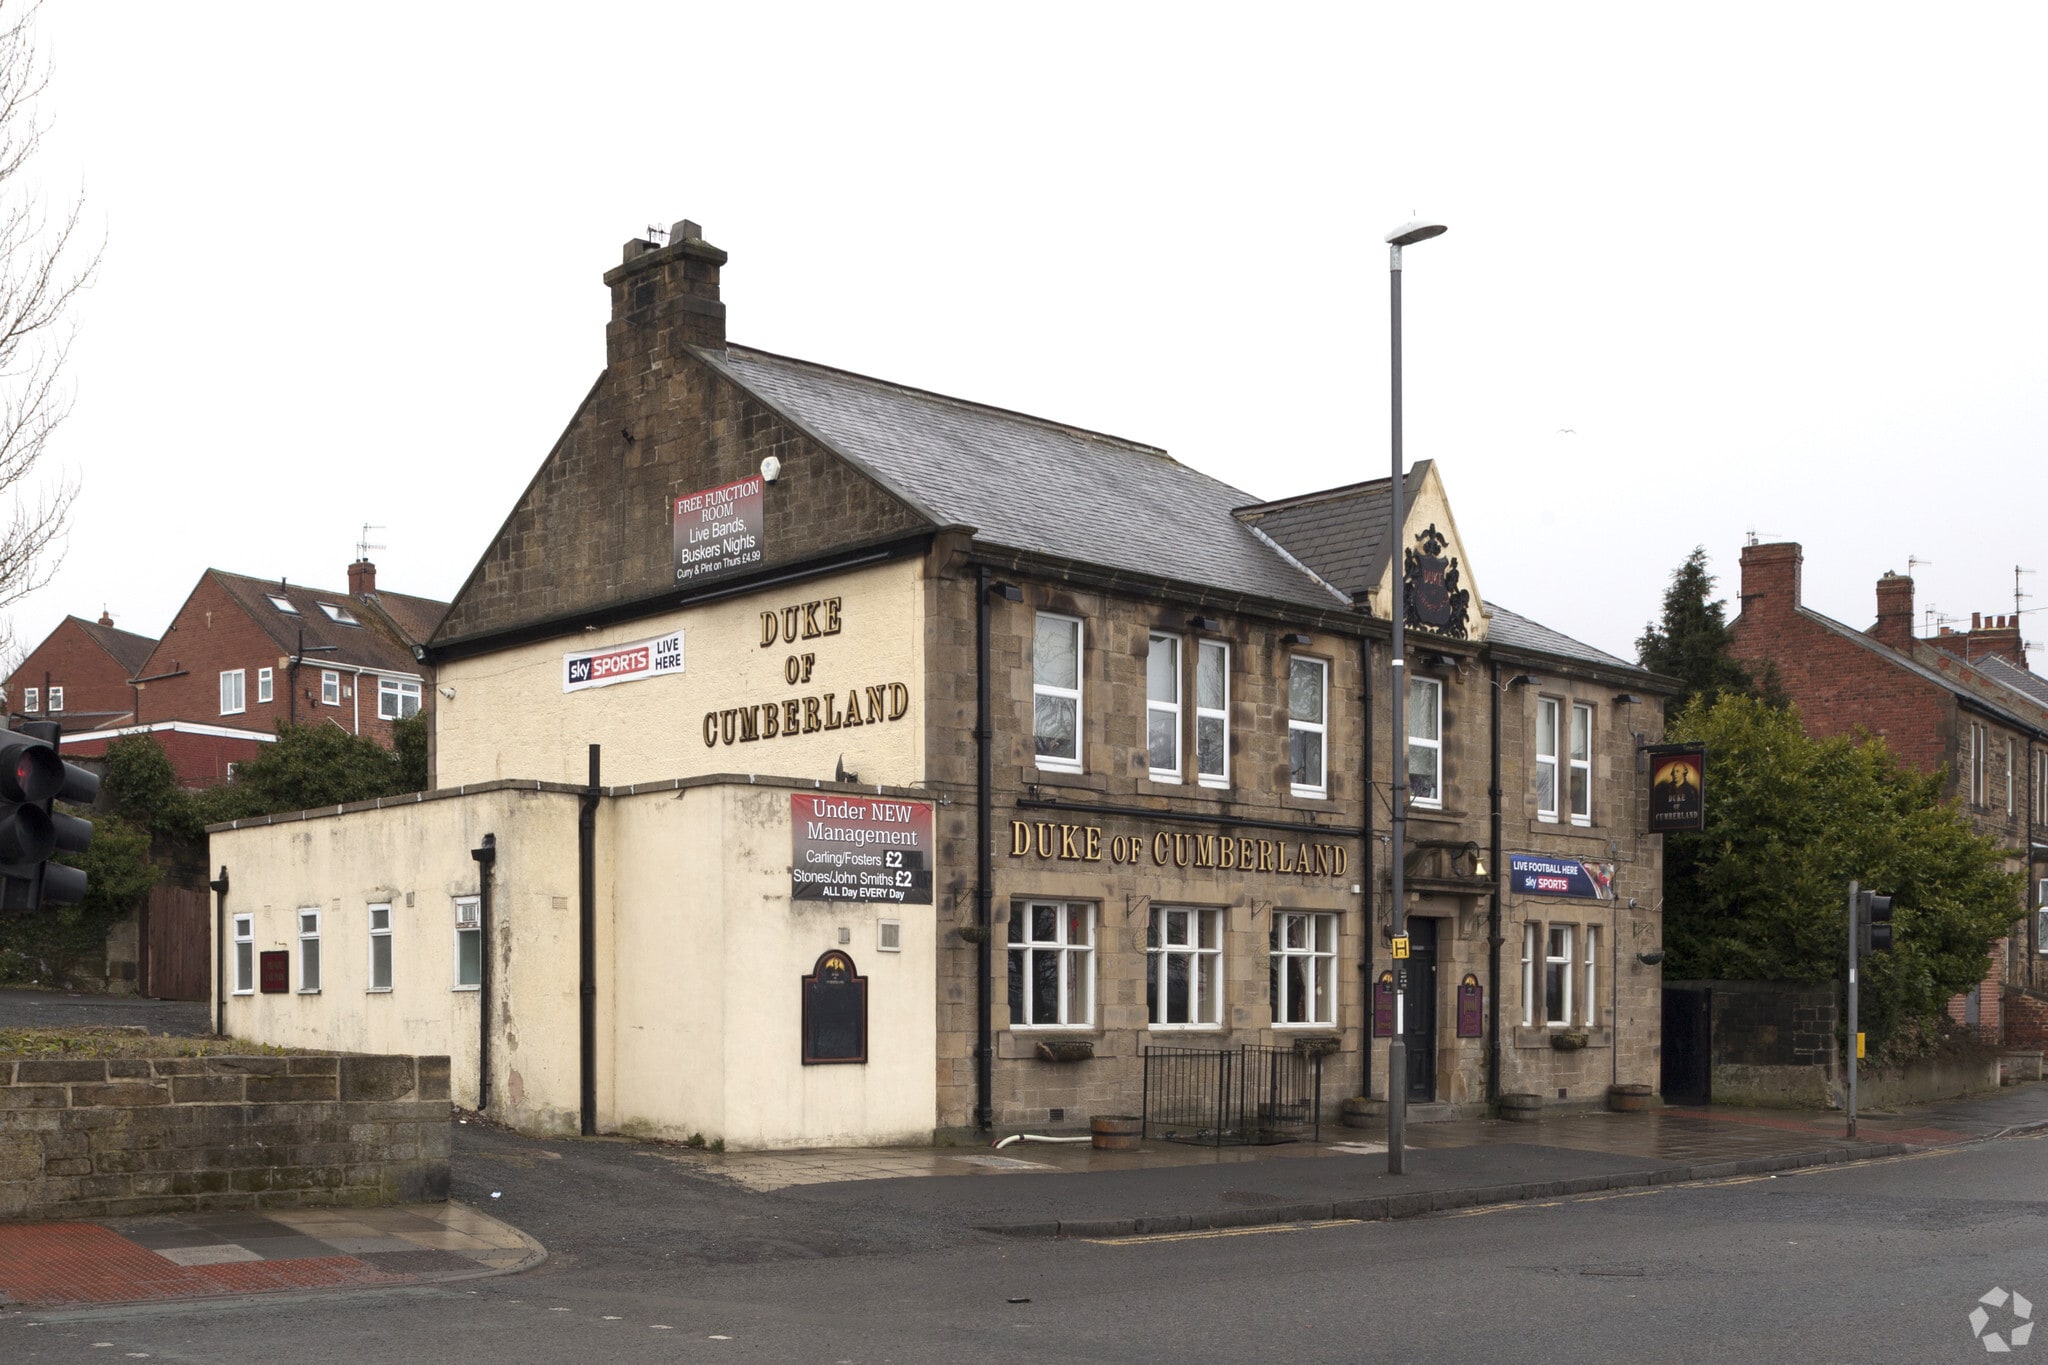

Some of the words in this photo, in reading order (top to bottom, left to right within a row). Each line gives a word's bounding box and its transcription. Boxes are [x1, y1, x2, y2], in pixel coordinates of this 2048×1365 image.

[678, 496, 702, 514] FREE
[705, 480, 759, 507] FUNCTION
[702, 502, 734, 522] ROOM
[690, 527, 709, 544] Live
[712, 517, 746, 538] Bands,
[682, 544, 720, 564] Buskers
[723, 534, 756, 556] Nights
[677, 568, 694, 579] Curry
[694, 565, 700, 574] &
[700, 562, 713, 573] Pint
[714, 561, 722, 570] on
[722, 557, 740, 568] Thurs
[742, 550, 760, 564] £4.99
[760, 597, 841, 648] DUKE
[657, 638, 679, 654] LIVE
[571, 660, 590, 680] sky
[594, 651, 646, 676] SPORTS
[655, 654, 681, 670] HERE
[784, 653, 815, 684] OF
[702, 682, 909, 747] CUMBERLAND
[812, 799, 866, 820] Under
[872, 803, 912, 822] NEW
[807, 822, 918, 847] Management
[806, 850, 882, 867] Carling/Fosters
[886, 851, 902, 868] £2
[1010, 820, 1102, 861] DUKE
[1112, 835, 1143, 864] OF
[1153, 831, 1348, 876] CUMBERLAND
[794, 869, 857, 884] Stones/John
[860, 872, 894, 886] Smiths
[896, 871, 912, 887] £2
[1514, 861, 1528, 871] LIVE
[1528, 862, 1561, 874] FOOTBALL
[1562, 865, 1578, 875] HERE
[823, 886, 840, 896] ALL
[842, 888, 858, 899] Day
[860, 888, 888, 898] EVERY
[889, 888, 904, 901] Day
[1525, 876, 1536, 889] sky
[1538, 878, 1568, 890] SPORTS
[1395, 940, 1407, 957] H
